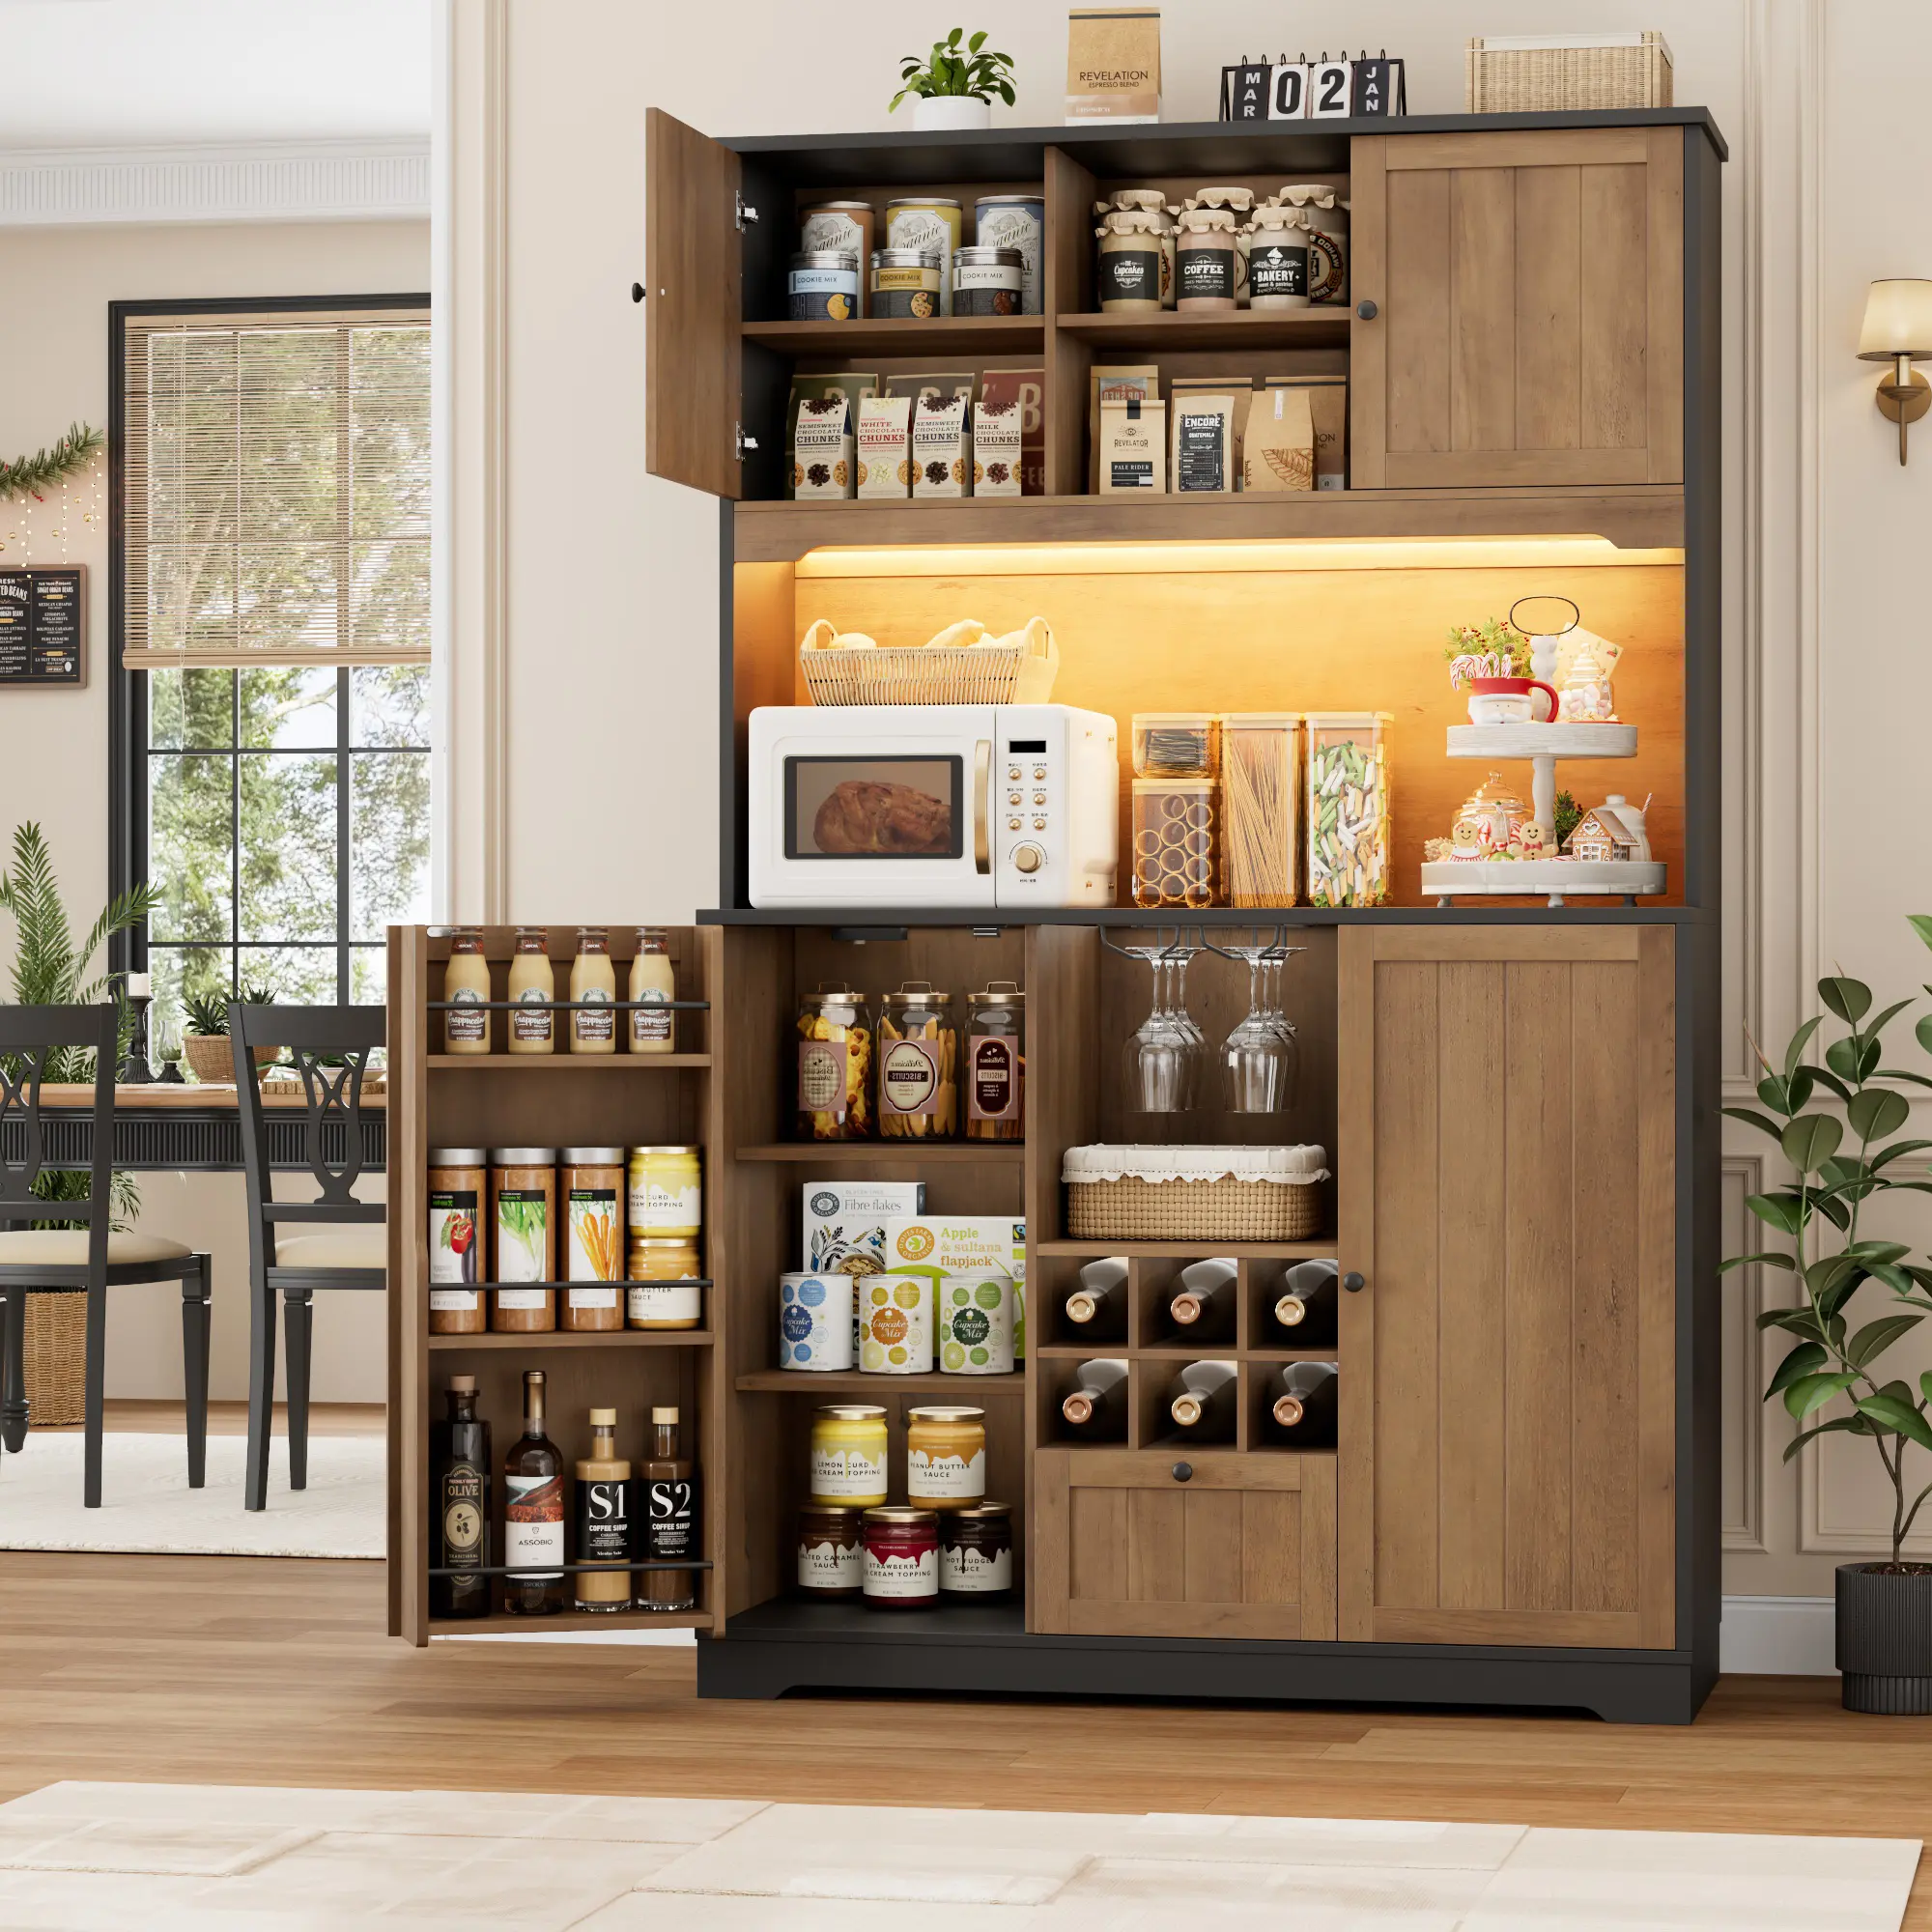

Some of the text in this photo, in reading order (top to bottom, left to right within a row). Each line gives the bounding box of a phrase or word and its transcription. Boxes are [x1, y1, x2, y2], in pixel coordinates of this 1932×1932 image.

[1079, 71, 1148, 81] REVELATION
[1243, 72, 1260, 117] MAR
[1365, 67, 1379, 111] JAN
[1114, 266, 1145, 276] Cupcakes
[1184, 265, 1224, 274] COFFEE
[1257, 270, 1294, 282] BAKERY
[1184, 417, 1221, 427] ENCORE
[1114, 439, 1149, 448] REVELATOR
[844, 1199, 901, 1210] Fibre flakes
[940, 1228, 979, 1240] Apple
[940, 1241, 1003, 1253] & sultana
[940, 1255, 993, 1268] flapjack
[790, 1324, 807, 1335] Mix
[872, 1319, 905, 1330] Cupcake
[953, 1320, 987, 1330] Cupcake
[883, 1328, 902, 1338] Mix
[965, 1328, 984, 1339] Mix
[448, 1484, 479, 1496] OLIVE
[588, 1484, 627, 1520] S1
[649, 1483, 691, 1519] S2
